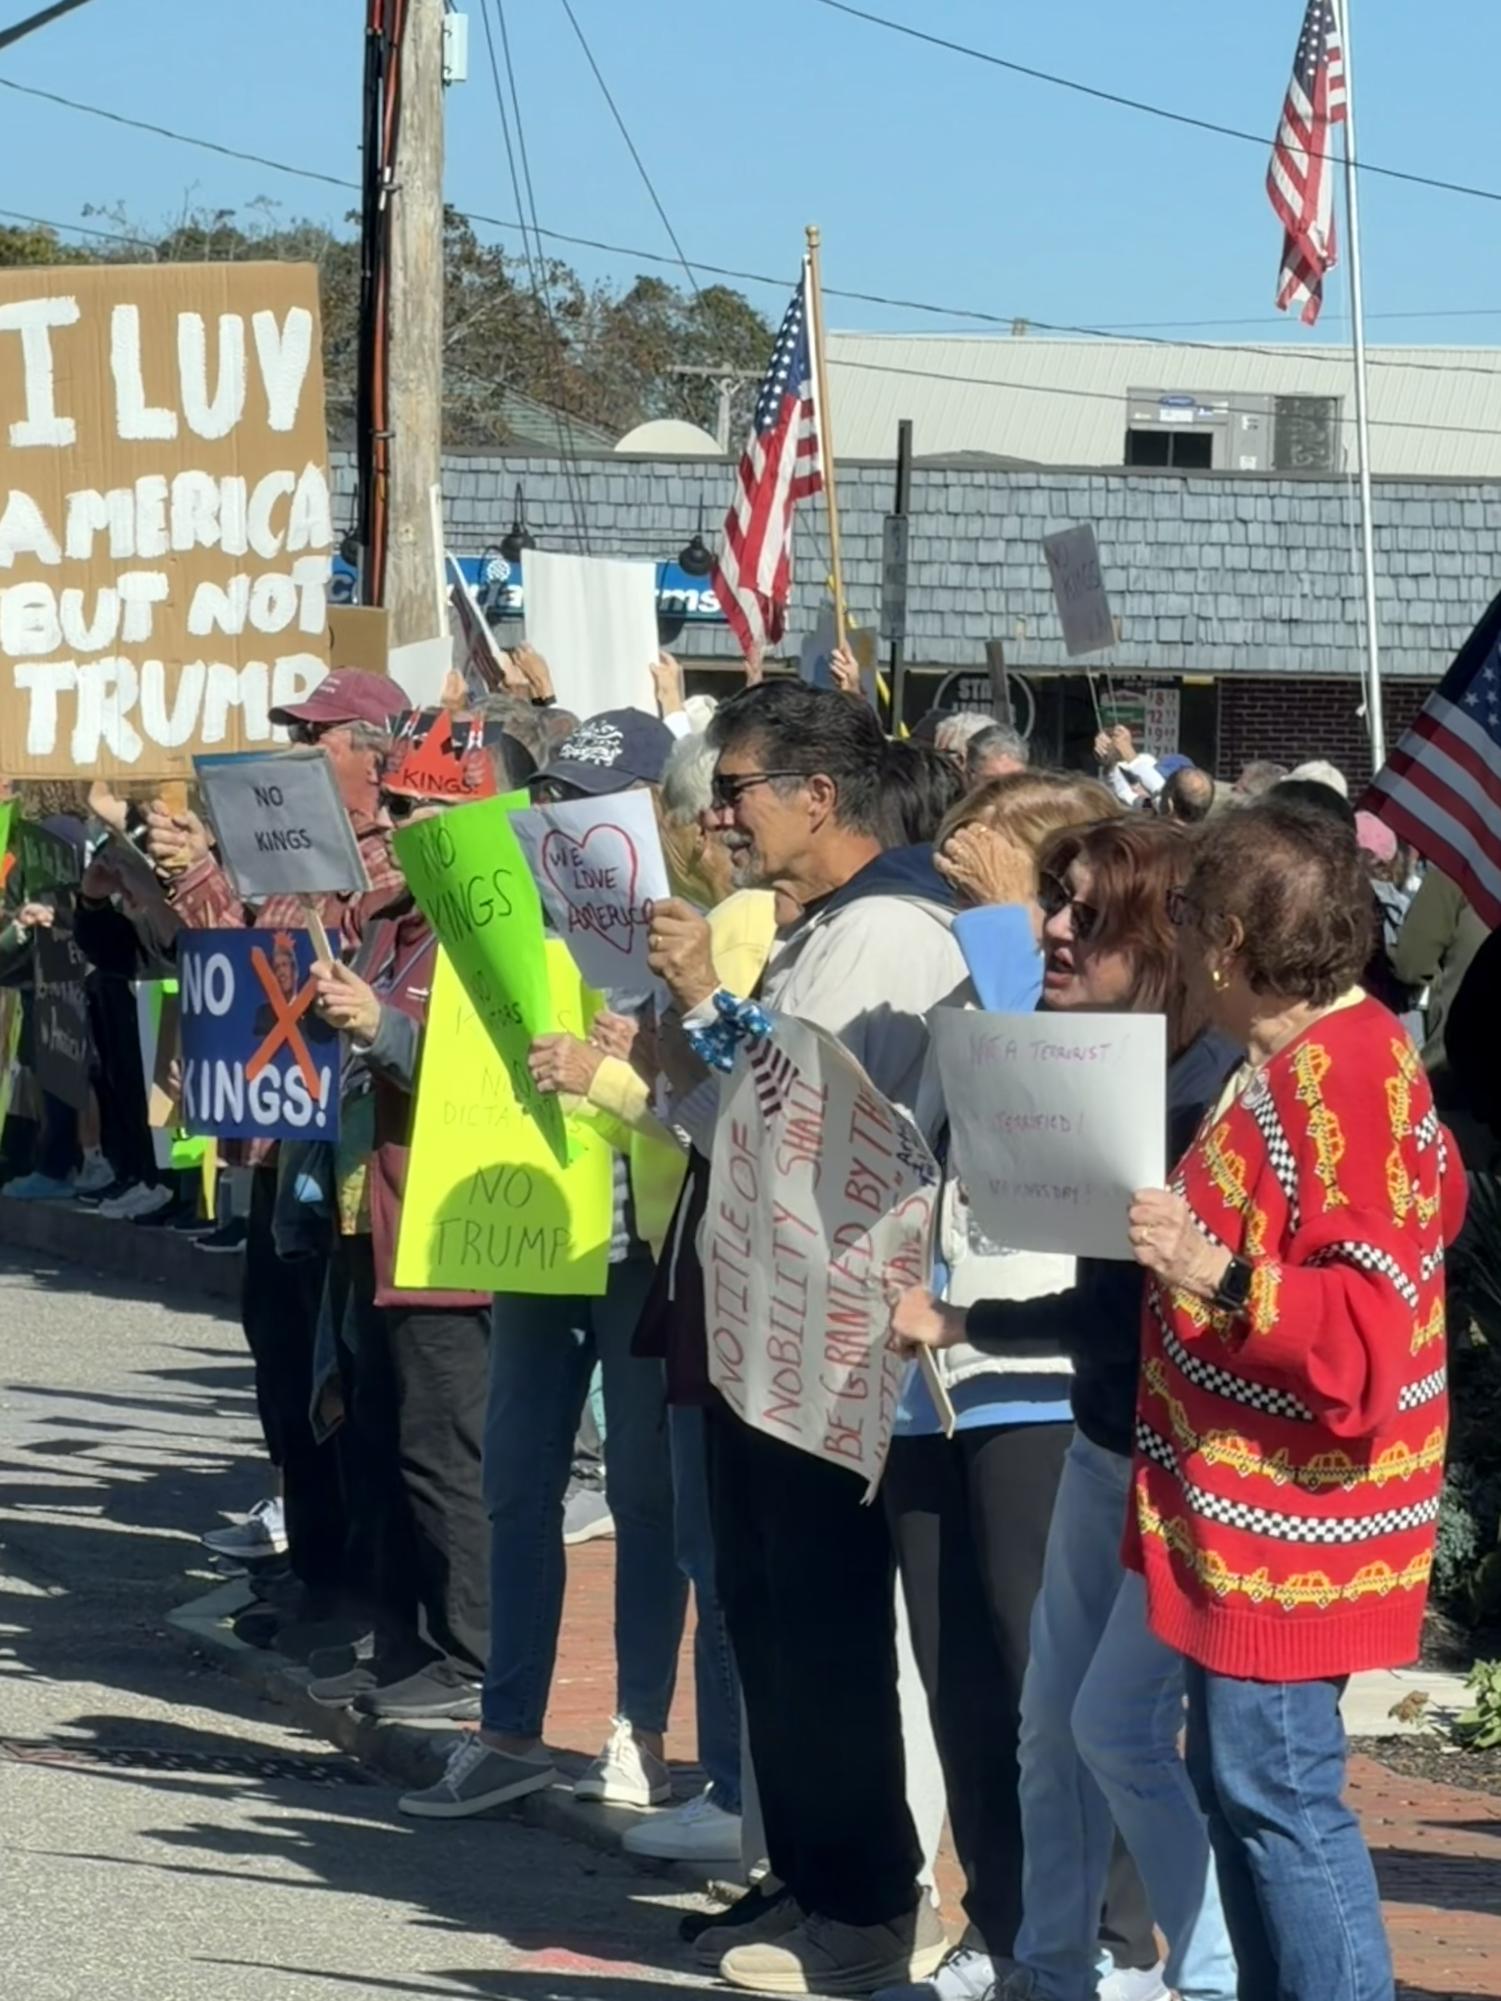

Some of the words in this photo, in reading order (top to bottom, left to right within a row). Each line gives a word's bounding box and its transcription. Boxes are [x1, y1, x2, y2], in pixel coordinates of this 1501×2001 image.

[0, 295, 81, 448] I
[110, 304, 313, 442] LUV
[0, 461, 334, 568] AMERICA
[0, 571, 169, 656] BUT
[187, 556, 331, 635] NOT
[14, 653, 330, 765] TRUMP
[254, 786, 284, 806] NO
[255, 829, 312, 851] KINGS
[420, 827, 456, 880] NO
[550, 848, 583, 867] WE
[574, 867, 619, 889] LOVE
[182, 952, 235, 1017] NO
[182, 1058, 332, 1129] KINGS!
[729, 1117, 758, 1202] OF
[774, 1081, 828, 1178] SHALL
[468, 1166, 533, 1208] NO
[842, 1158, 890, 1211] BY
[426, 1217, 576, 1271] TRUMP
[712, 1203, 751, 1325] TITLE
[762, 1200, 817, 1432] NOBILITY
[818, 1222, 872, 1400] GRANTED
[713, 1328, 745, 1412] NO
[822, 1410, 864, 1462] BE
